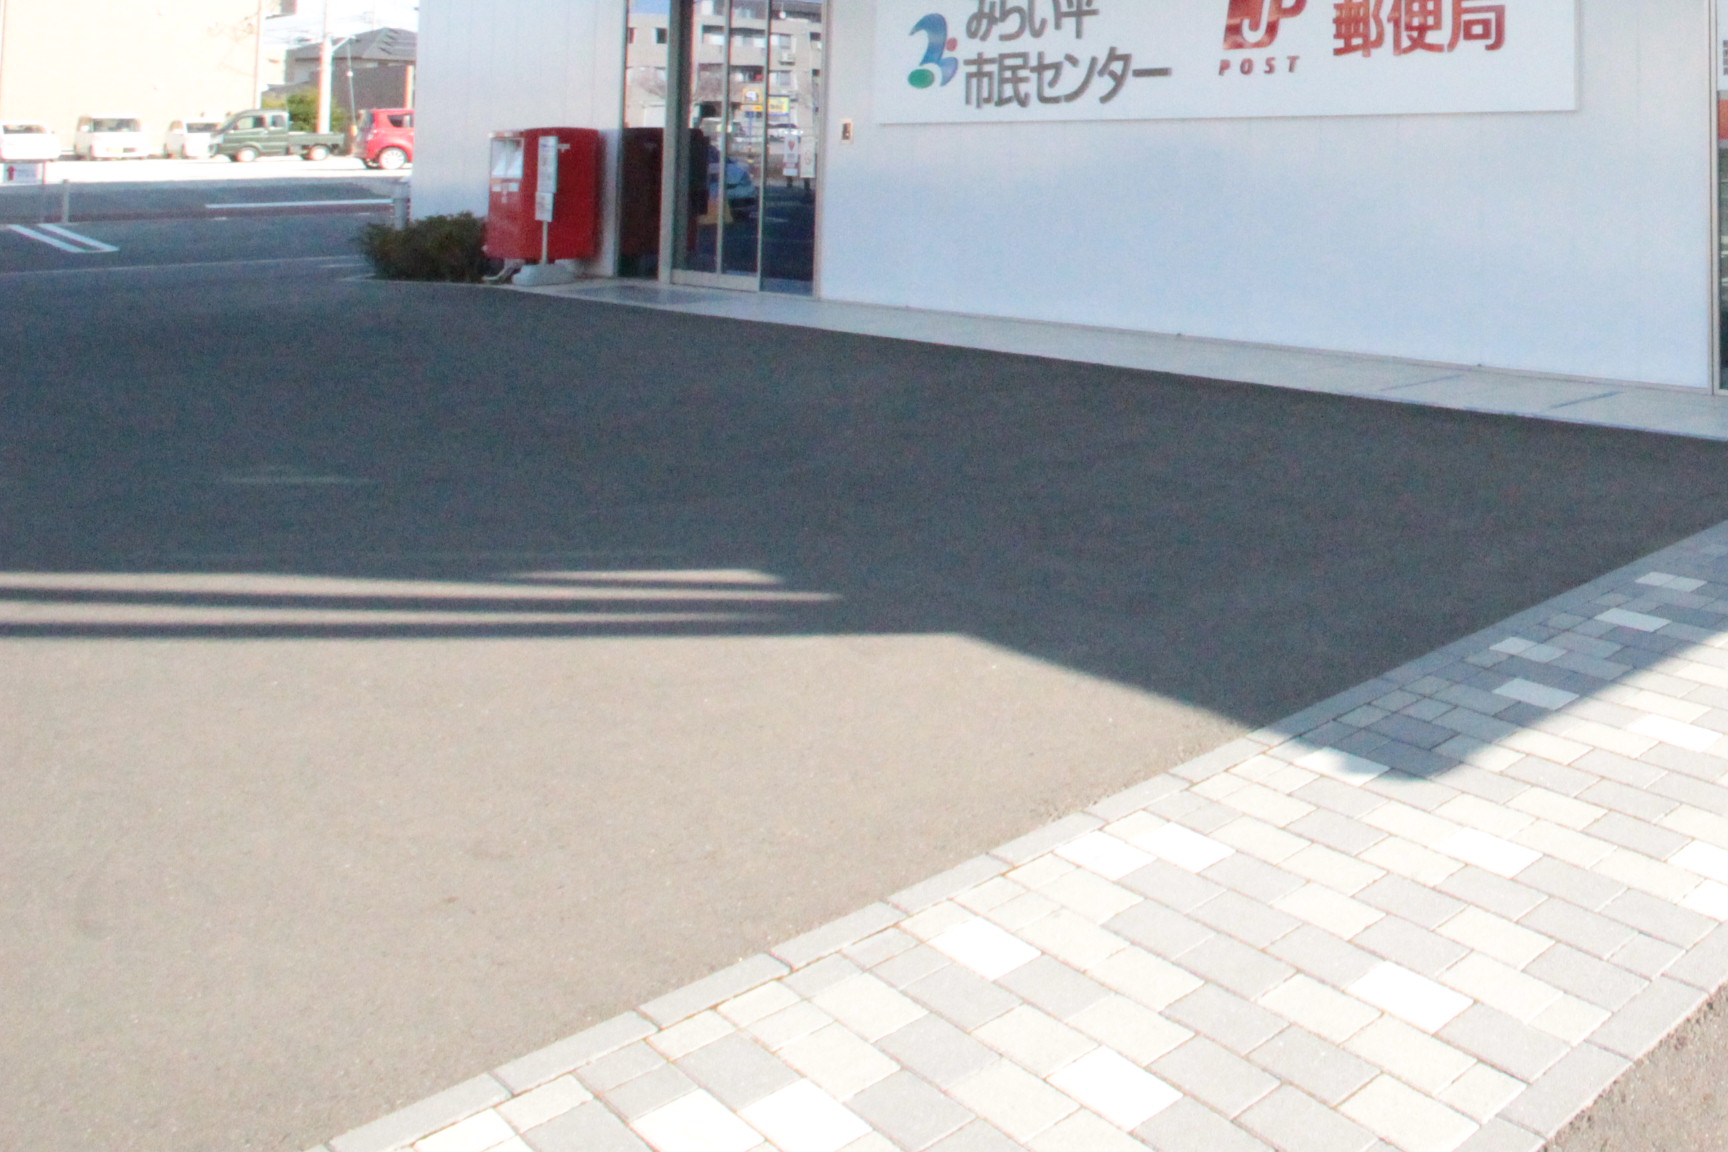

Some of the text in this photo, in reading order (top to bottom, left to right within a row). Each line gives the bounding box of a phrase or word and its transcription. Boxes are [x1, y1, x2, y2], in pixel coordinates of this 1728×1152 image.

[963, 46, 1172, 109] 市民センター
[1219, 55, 1300, 76] POST
